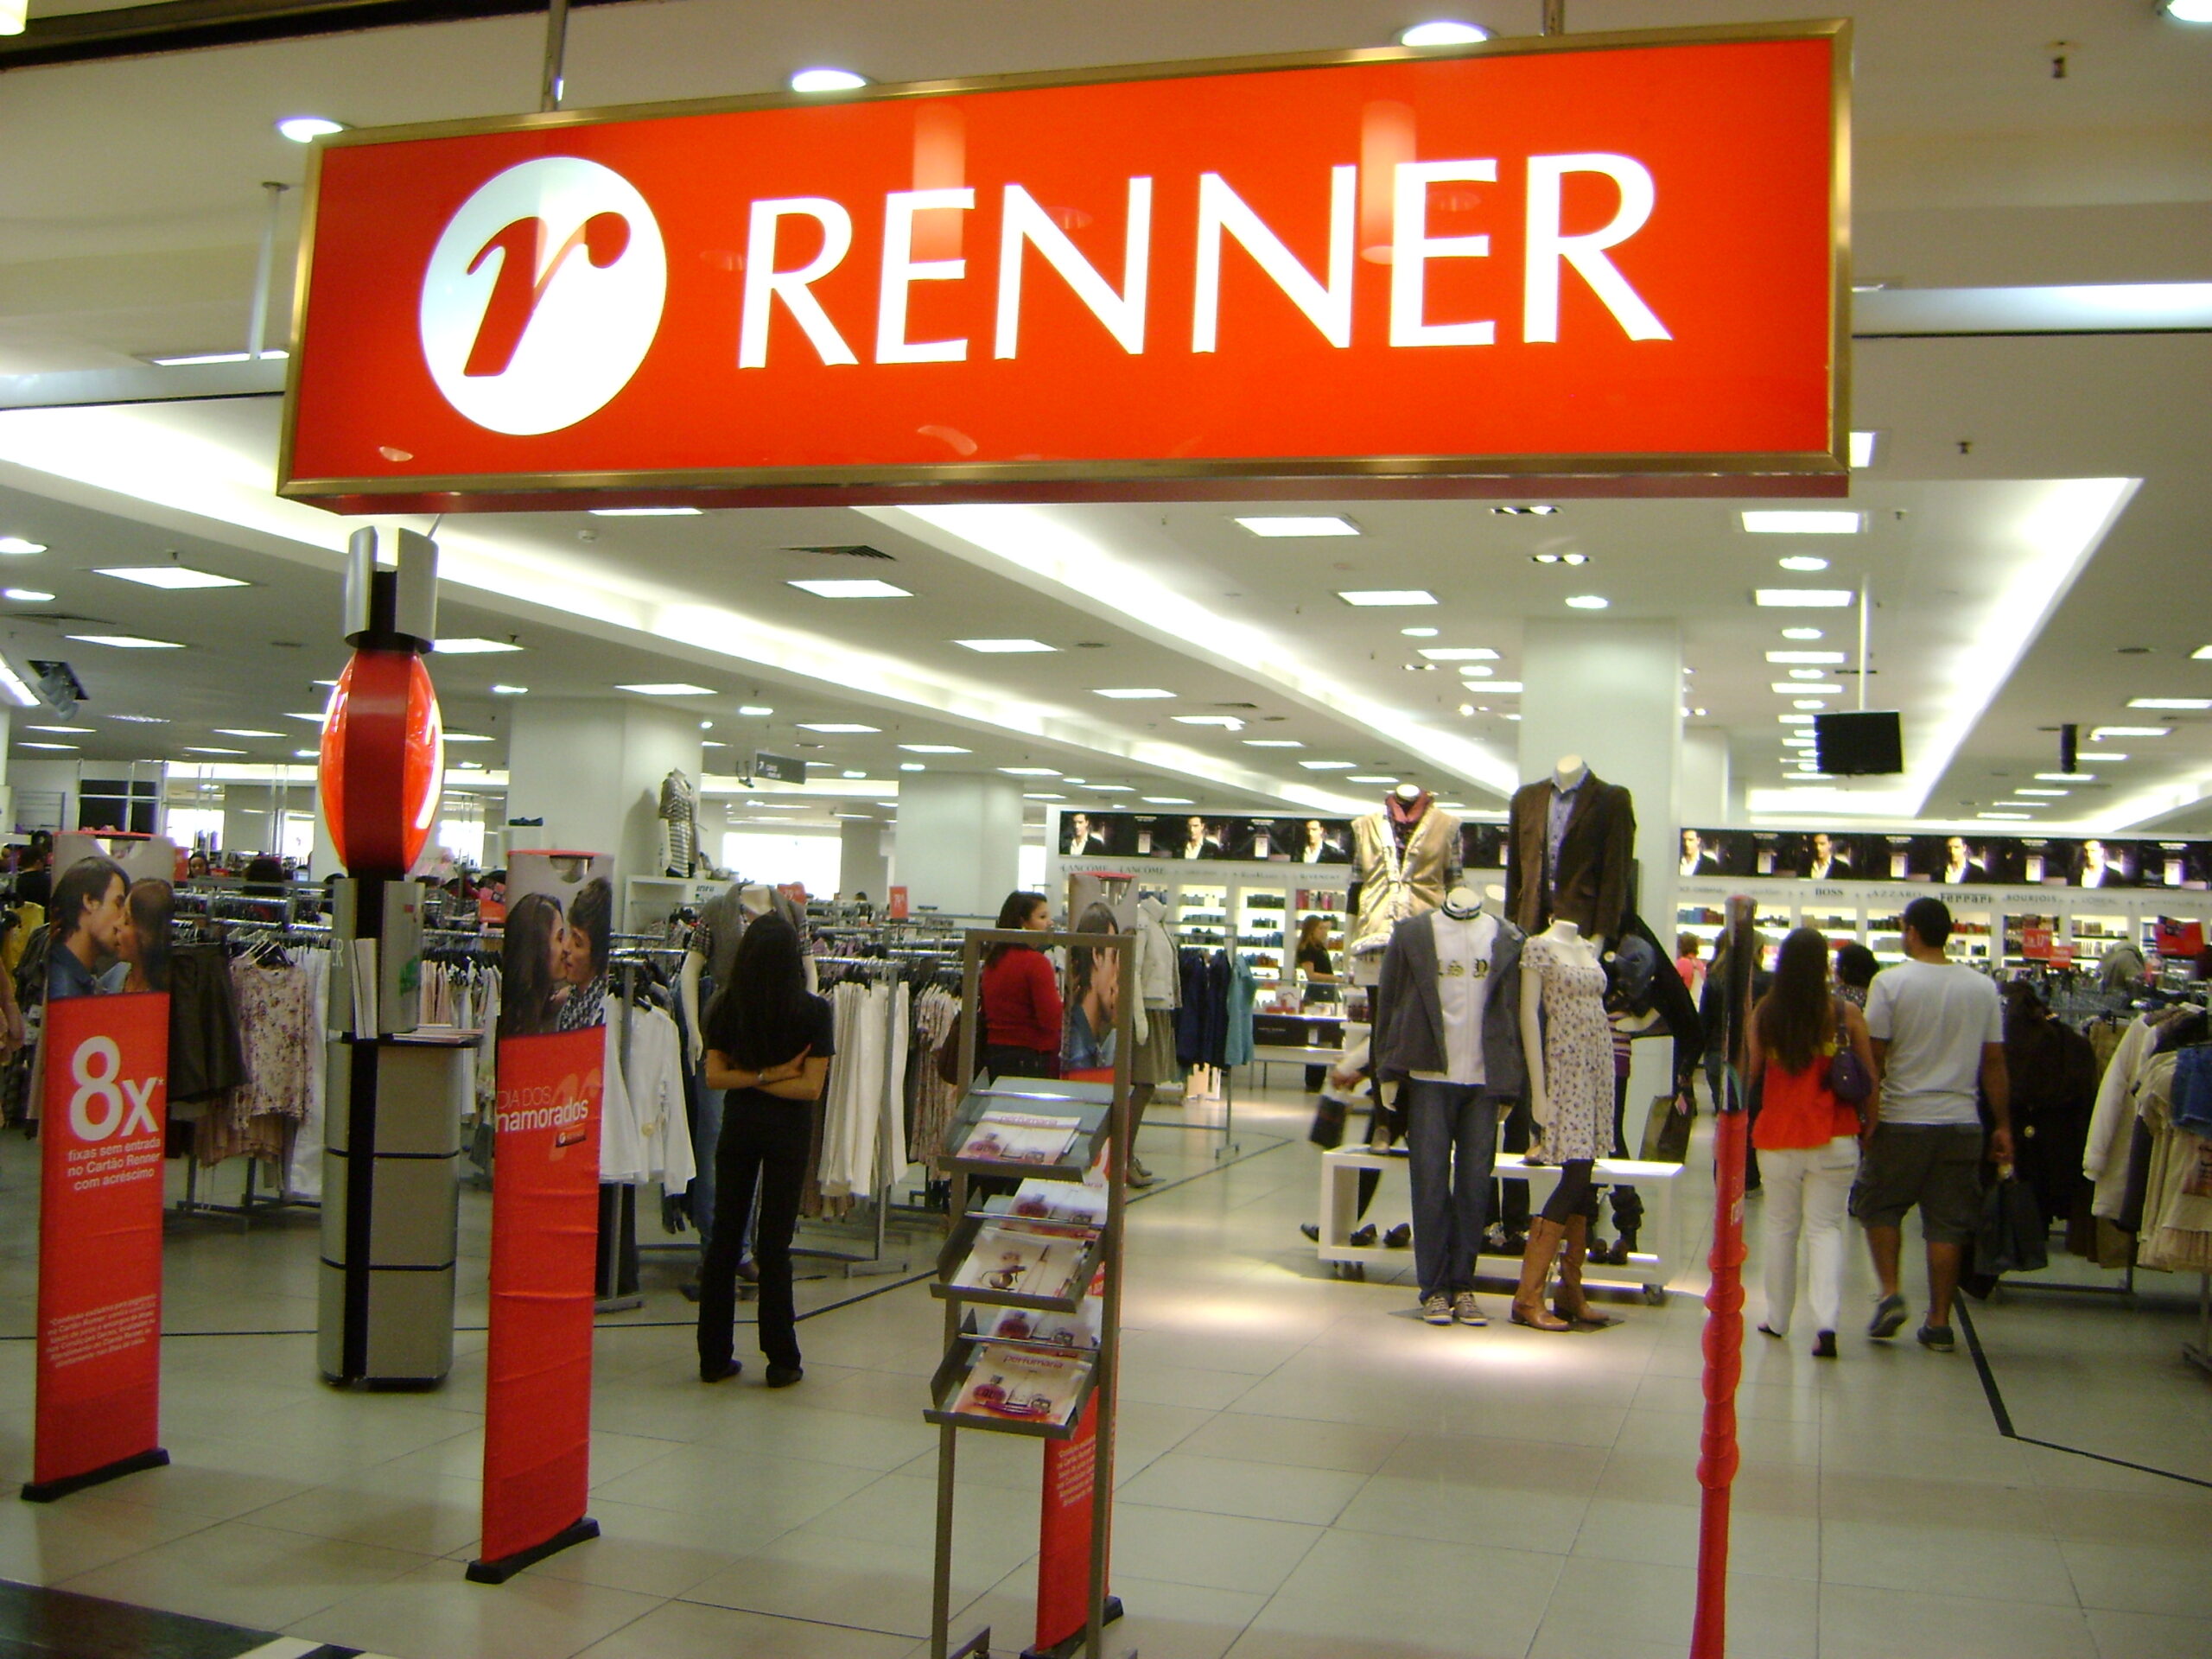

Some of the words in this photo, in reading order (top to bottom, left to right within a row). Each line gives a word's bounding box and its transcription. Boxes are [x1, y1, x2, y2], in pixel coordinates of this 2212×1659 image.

[739, 152, 1674, 369] RENNER
[1815, 887, 1843, 896] BOSS
[1871, 890, 1922, 899] AZZARO
[1941, 893, 1993, 904] Ferrari
[2005, 894, 2057, 903] BOURJOIS
[523, 1086, 551, 1106] DOS
[495, 1096, 589, 1133] namorados
[68, 1148, 97, 1162] fixas
[99, 1144, 123, 1157] sem
[124, 1137, 161, 1152] entrada
[67, 1166, 84, 1177] no
[86, 1157, 124, 1173] Cartão
[126, 1153, 161, 1166] Renner
[74, 1178, 100, 1191] com
[1003, 1354, 1064, 1369] perfumaria
